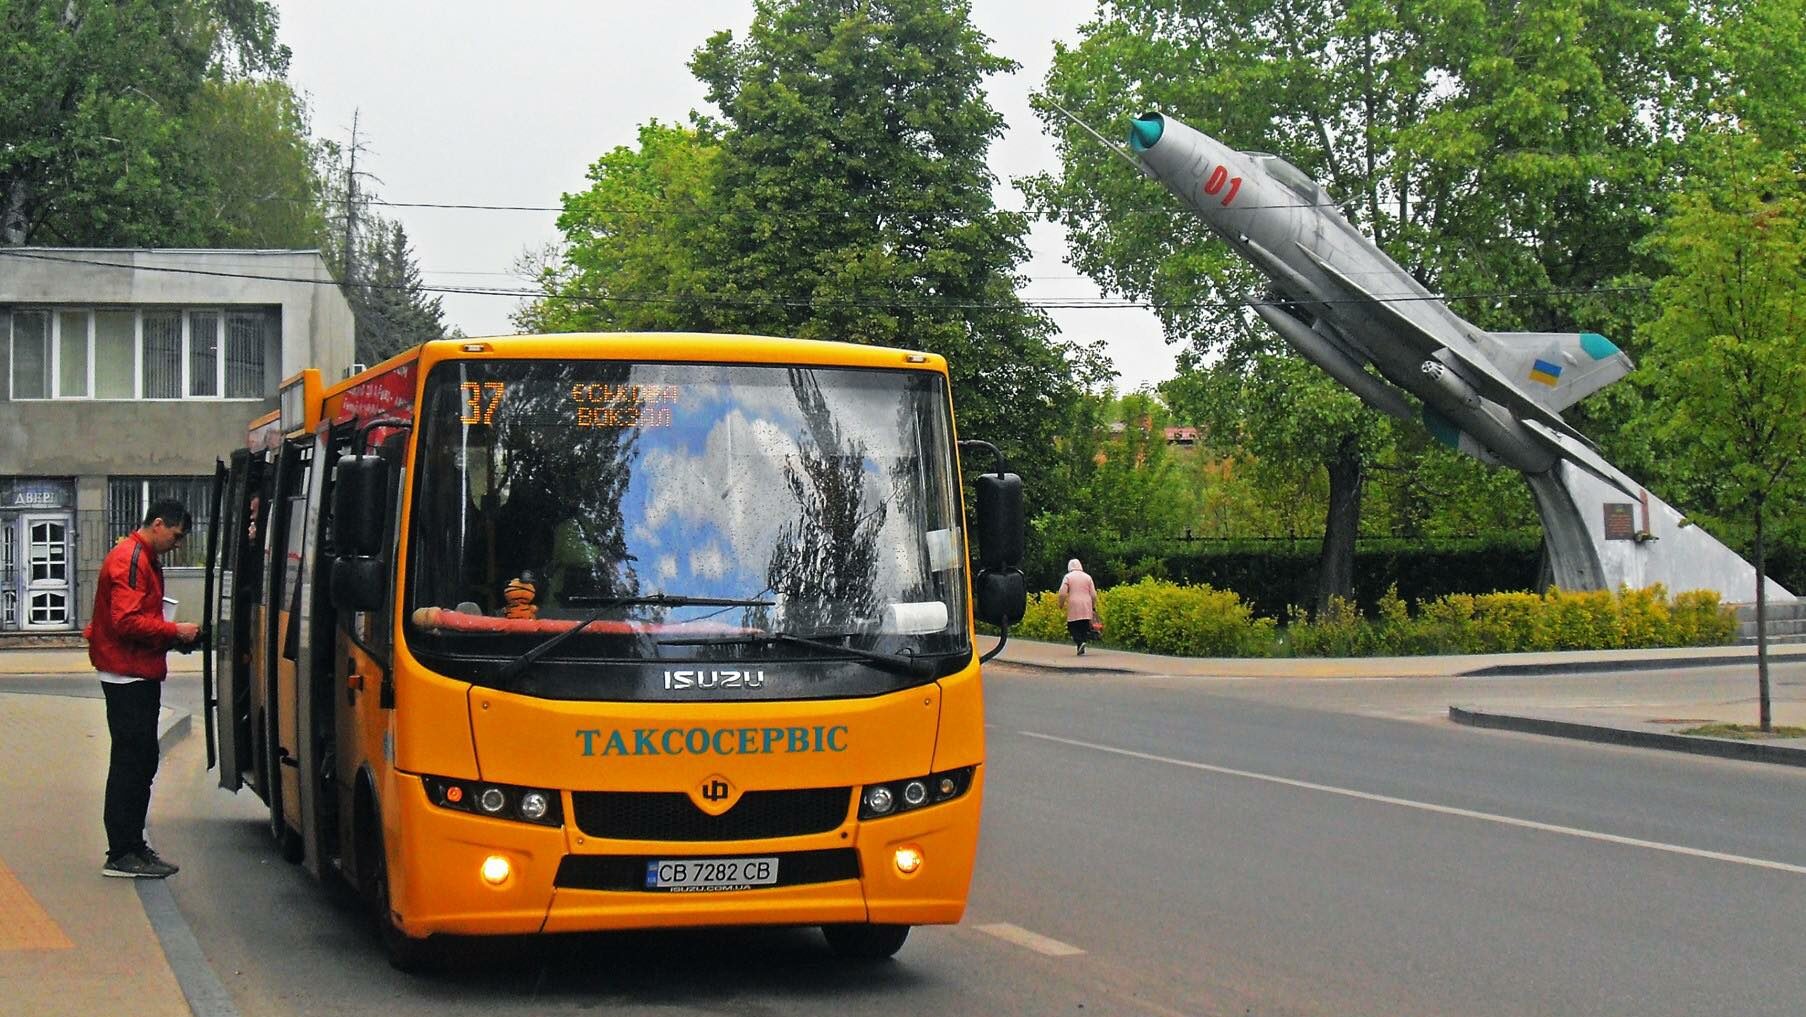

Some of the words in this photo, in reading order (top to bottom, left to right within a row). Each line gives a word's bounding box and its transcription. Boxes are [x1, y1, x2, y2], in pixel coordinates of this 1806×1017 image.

[1205, 165, 1242, 207] 01
[460, 381, 505, 425] 37
[577, 407, 673, 428] ВОКЗАЛ
[664, 670, 764, 690] ISUZU
[575, 725, 849, 757] ТАКСОСЕРВІС
[693, 863, 738, 881] 7282
[670, 884, 752, 893] ISUZU.COM.UA
